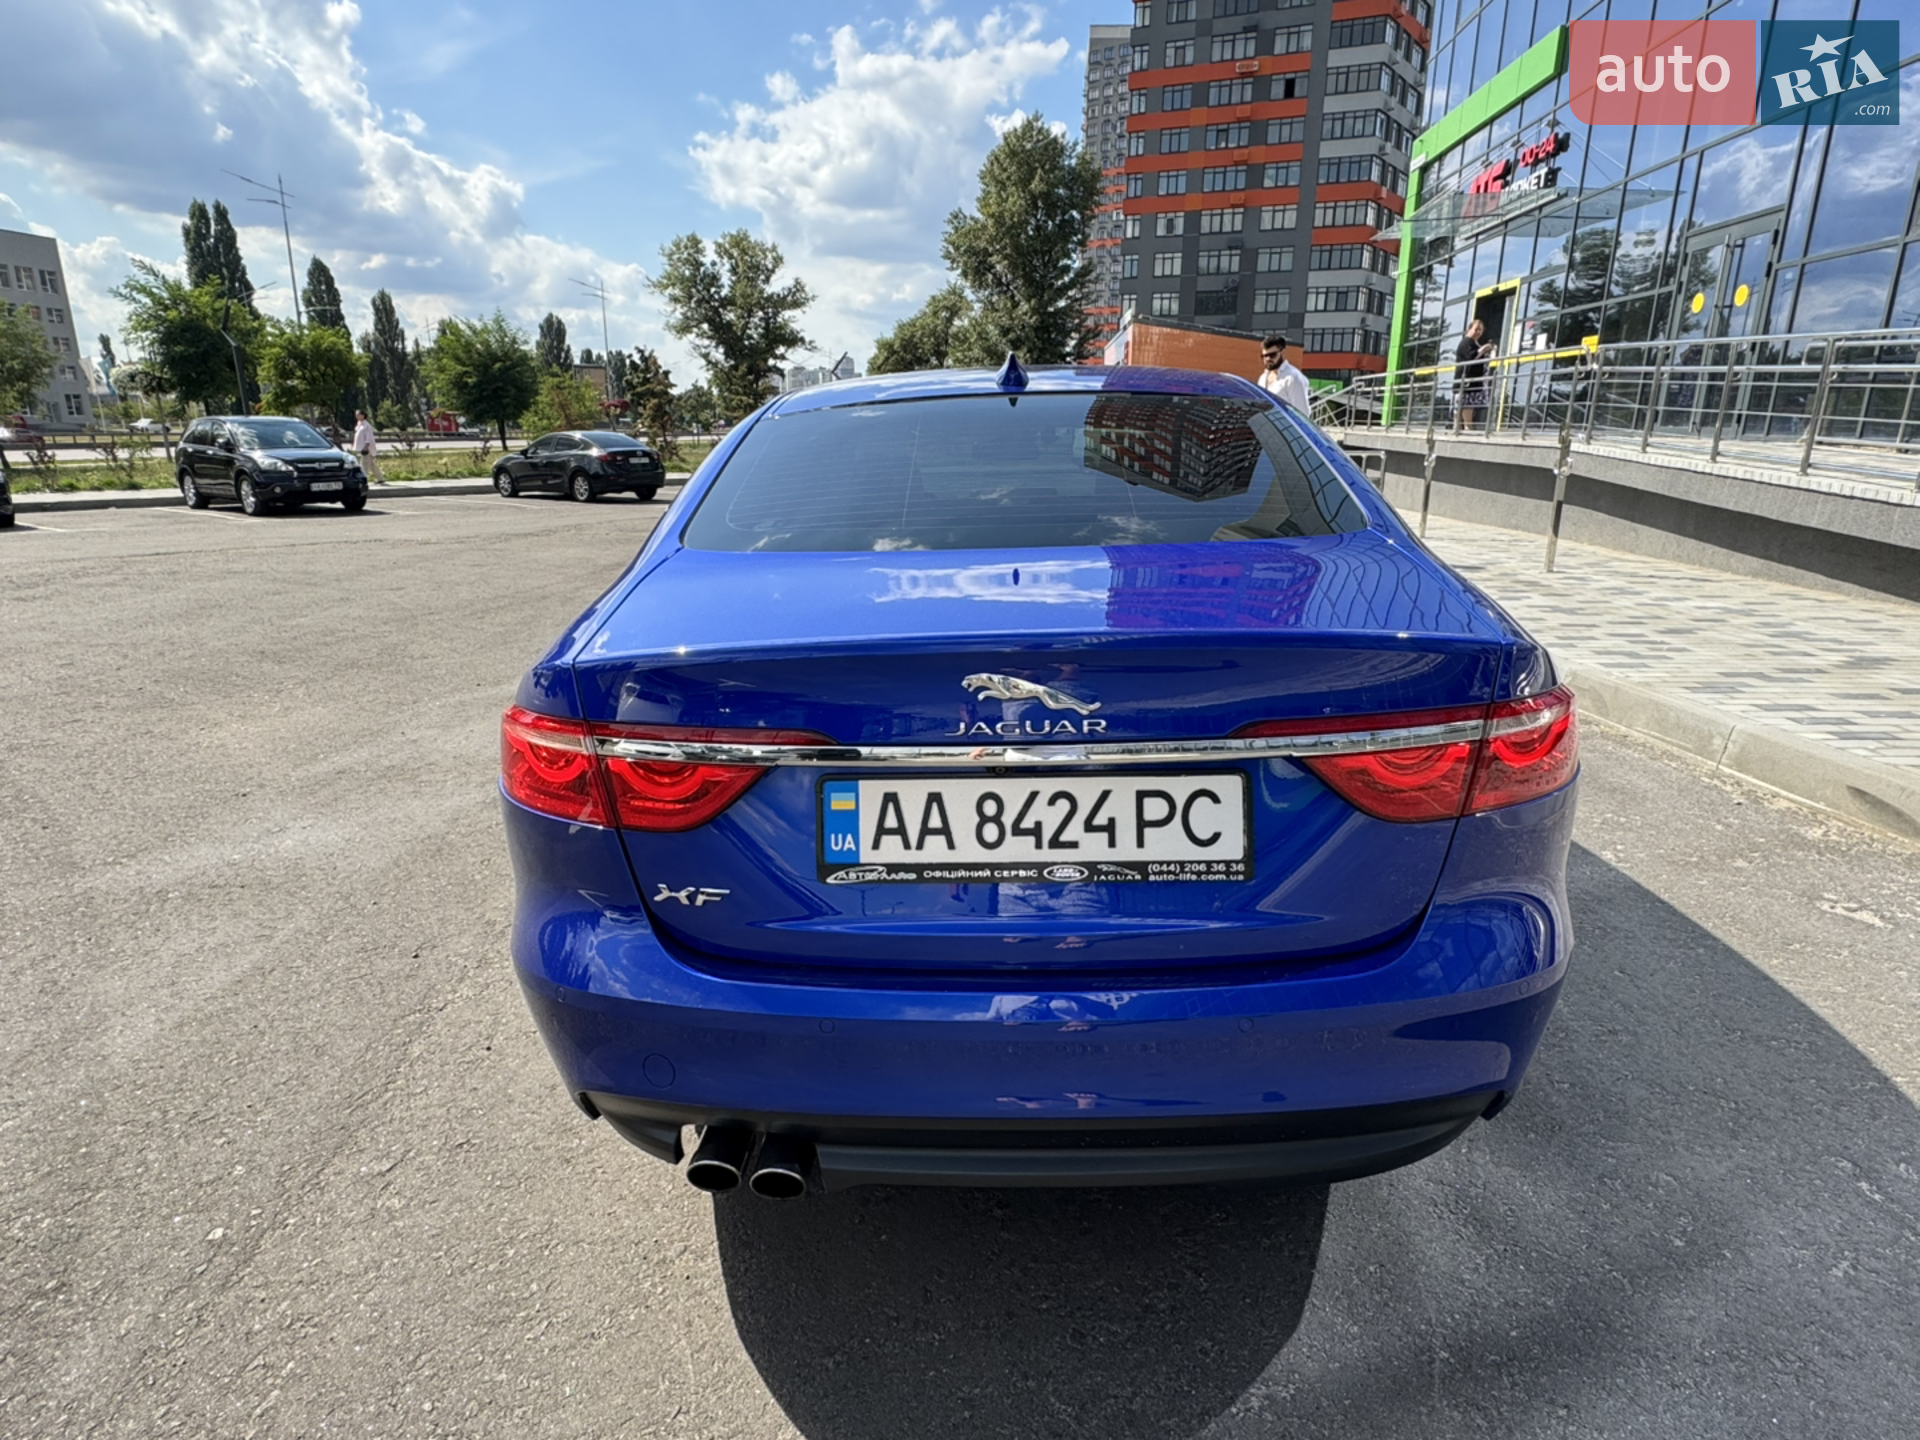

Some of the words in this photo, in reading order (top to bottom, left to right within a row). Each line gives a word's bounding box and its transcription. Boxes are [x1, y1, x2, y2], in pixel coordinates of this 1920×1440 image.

[944, 718, 1108, 737] JAGUAR
[871, 791, 956, 851] AA
[975, 789, 1118, 850] 8424
[1135, 787, 1223, 849] PC
[830, 833, 857, 852] UA
[994, 869, 1039, 878] СЕРВІС
[1147, 862, 1181, 874] (044)
[1183, 862, 1207, 872] 206
[1210, 862, 1227, 872] 36
[1229, 862, 1245, 872] 36
[1093, 874, 1142, 882] JAGUAR
[1148, 872, 1245, 882] auto-life.com.ua
[653, 883, 731, 907] XF
